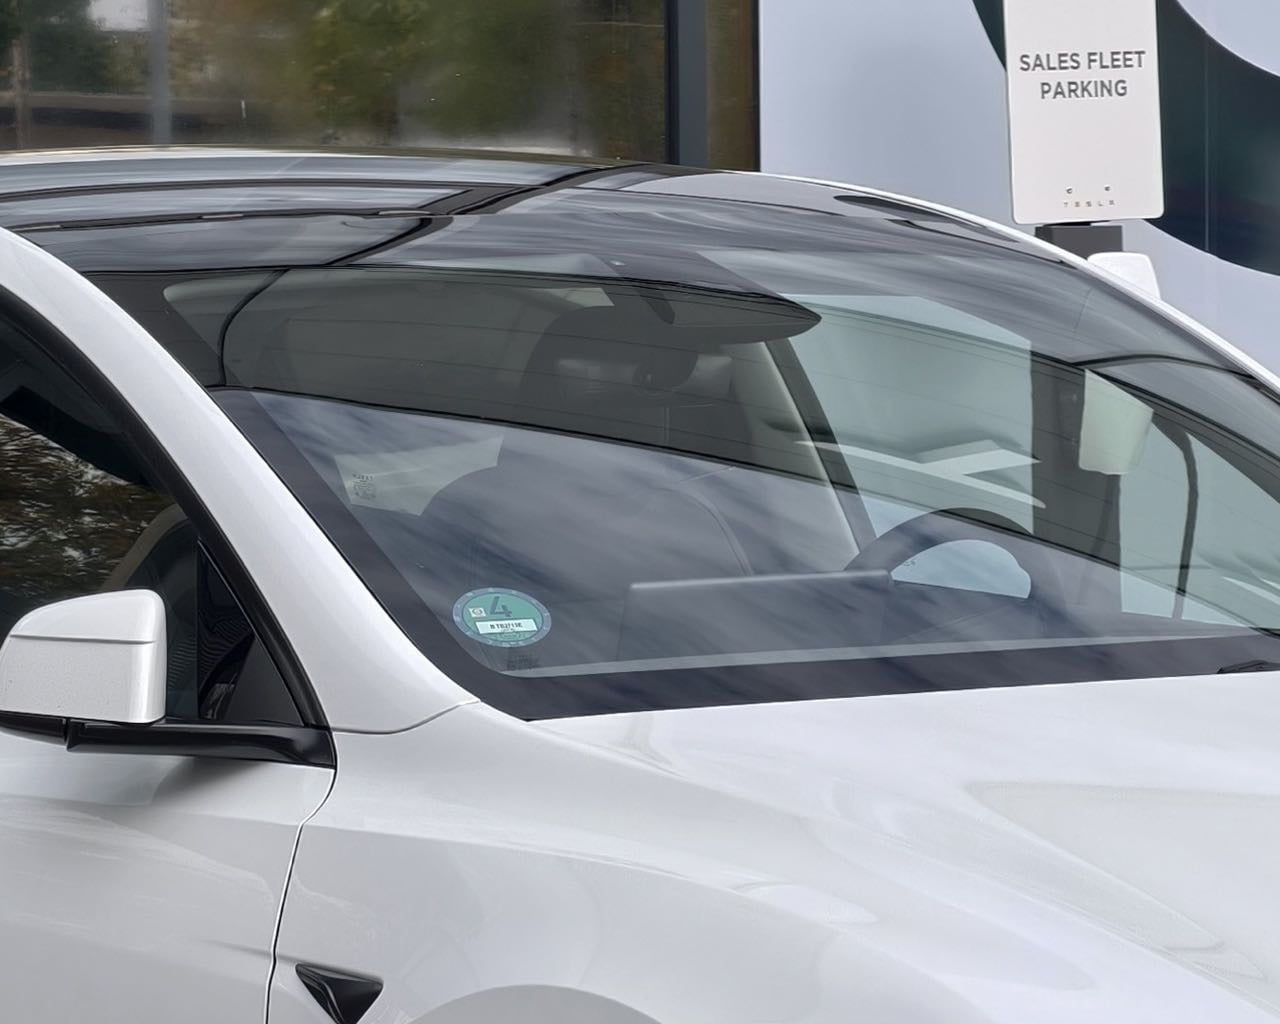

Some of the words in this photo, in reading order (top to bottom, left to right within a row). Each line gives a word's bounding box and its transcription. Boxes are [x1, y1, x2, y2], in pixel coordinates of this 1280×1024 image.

[1019, 52, 1081, 72] SALES
[1086, 50, 1147, 70] FLEET
[1040, 79, 1128, 99] PARKING
[490, 595, 513, 617] 4
